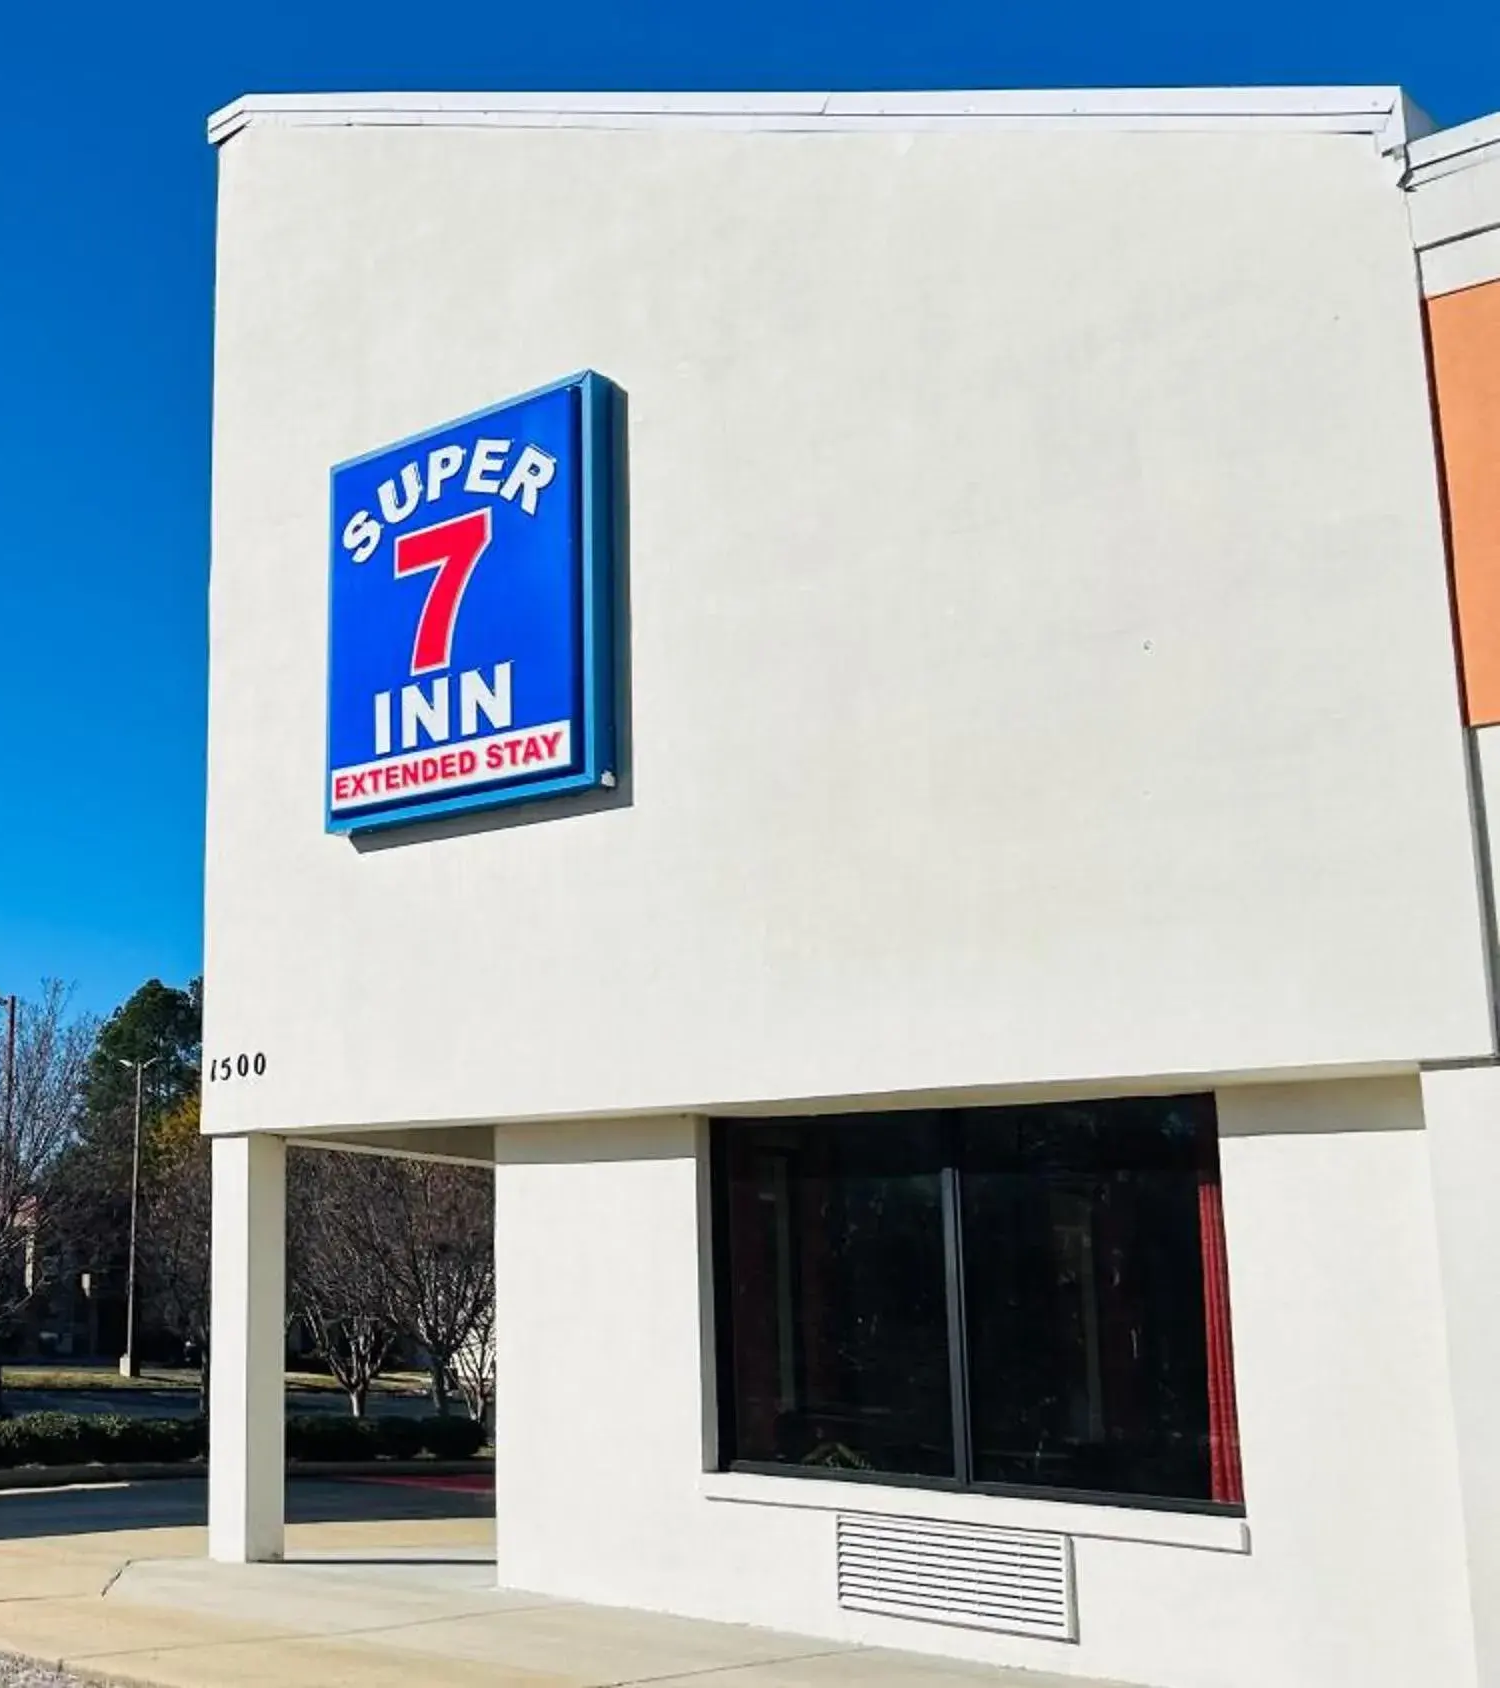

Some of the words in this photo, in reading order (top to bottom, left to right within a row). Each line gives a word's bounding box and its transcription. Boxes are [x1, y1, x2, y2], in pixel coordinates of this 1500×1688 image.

[341, 437, 557, 563] SUPER
[393, 506, 493, 677] 7
[374, 660, 514, 755] INN
[334, 750, 477, 801] EXTENDED
[485, 730, 563, 769] STAY
[210, 1052, 266, 1082] 1500
